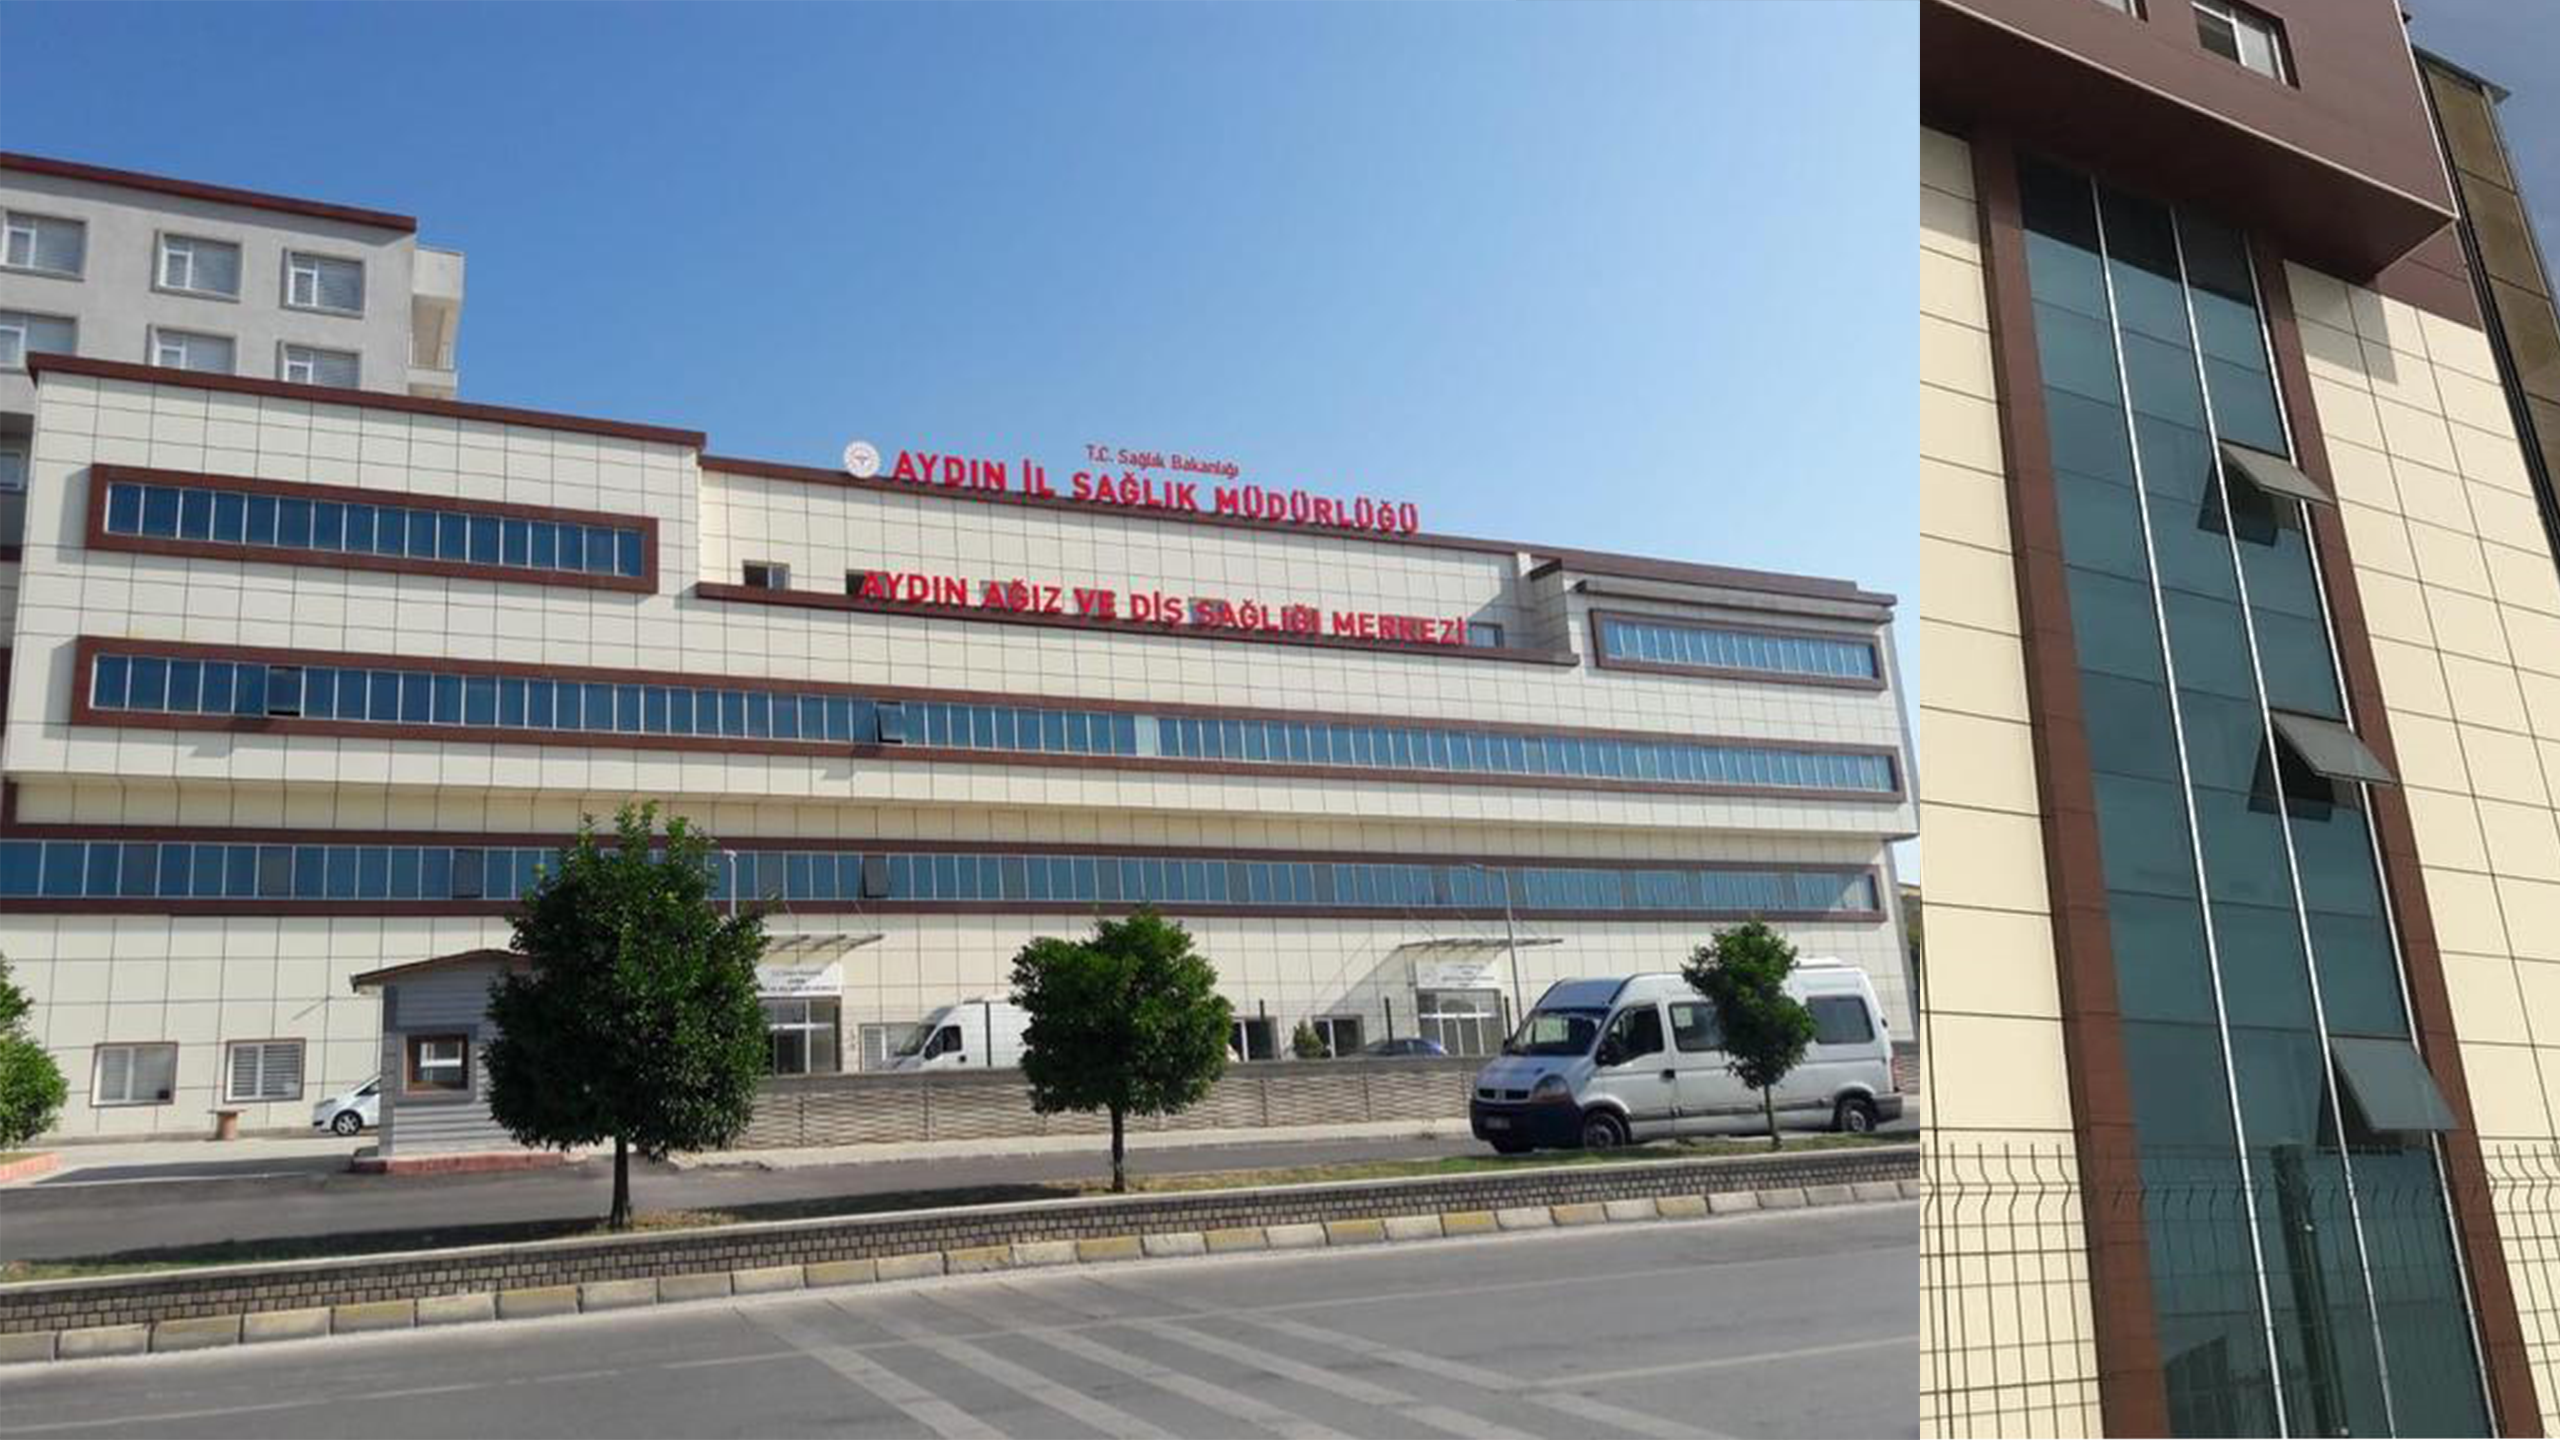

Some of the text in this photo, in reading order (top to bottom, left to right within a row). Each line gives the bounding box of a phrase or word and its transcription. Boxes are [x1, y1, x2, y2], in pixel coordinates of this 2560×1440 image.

[892, 450, 1419, 534] AYDIN İL SAĞLIK MÜDÜRLÜĞÜ
[1086, 443, 1239, 480] T.C. Sağlık Bakanlığı
[861, 570, 1467, 645] AYDIN AĞIZ VE DİŞ SAĞLIĞI MERKEZİ
